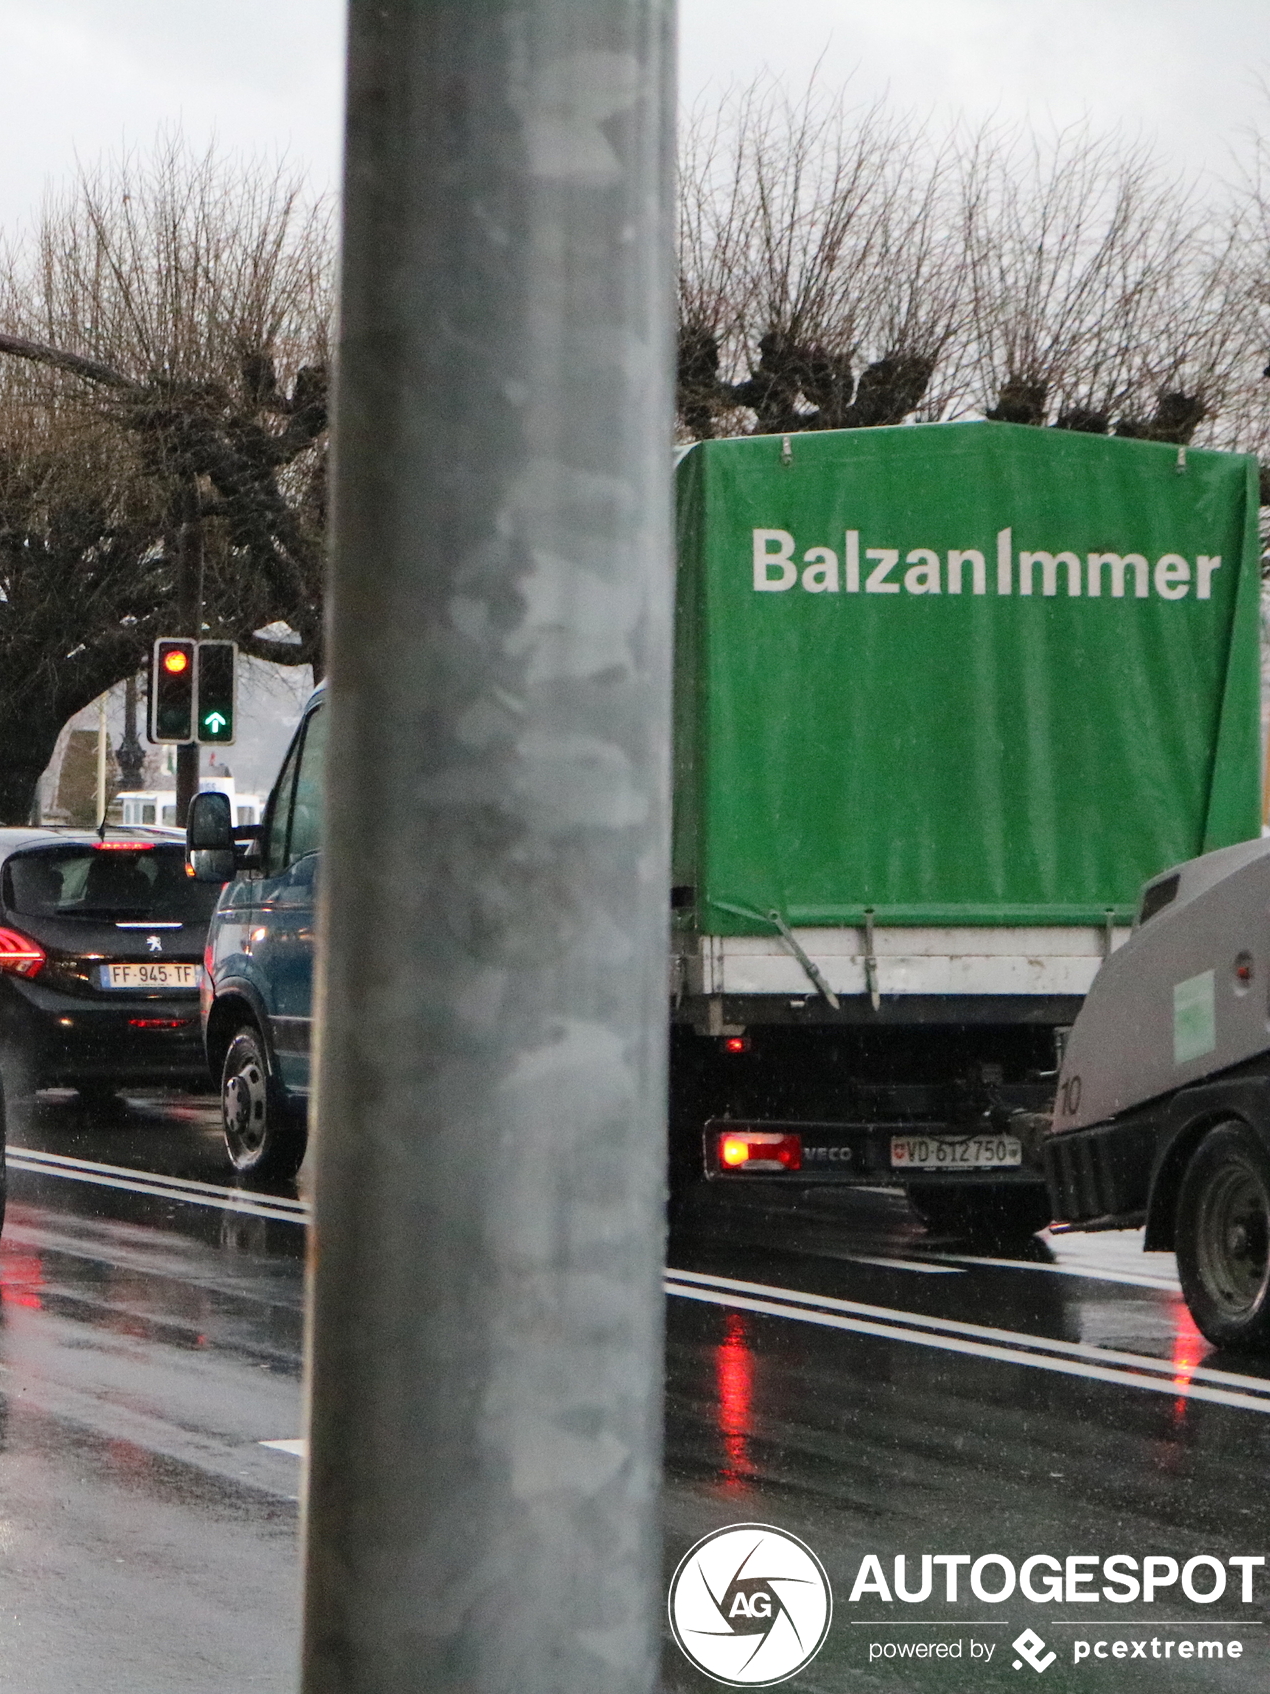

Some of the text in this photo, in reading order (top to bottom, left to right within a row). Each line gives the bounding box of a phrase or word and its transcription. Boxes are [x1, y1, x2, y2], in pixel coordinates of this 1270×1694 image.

[752, 526, 1222, 600] BalzanImmer
[1061, 1075, 1082, 1116] 10
[803, 1146, 852, 1161] VECO
